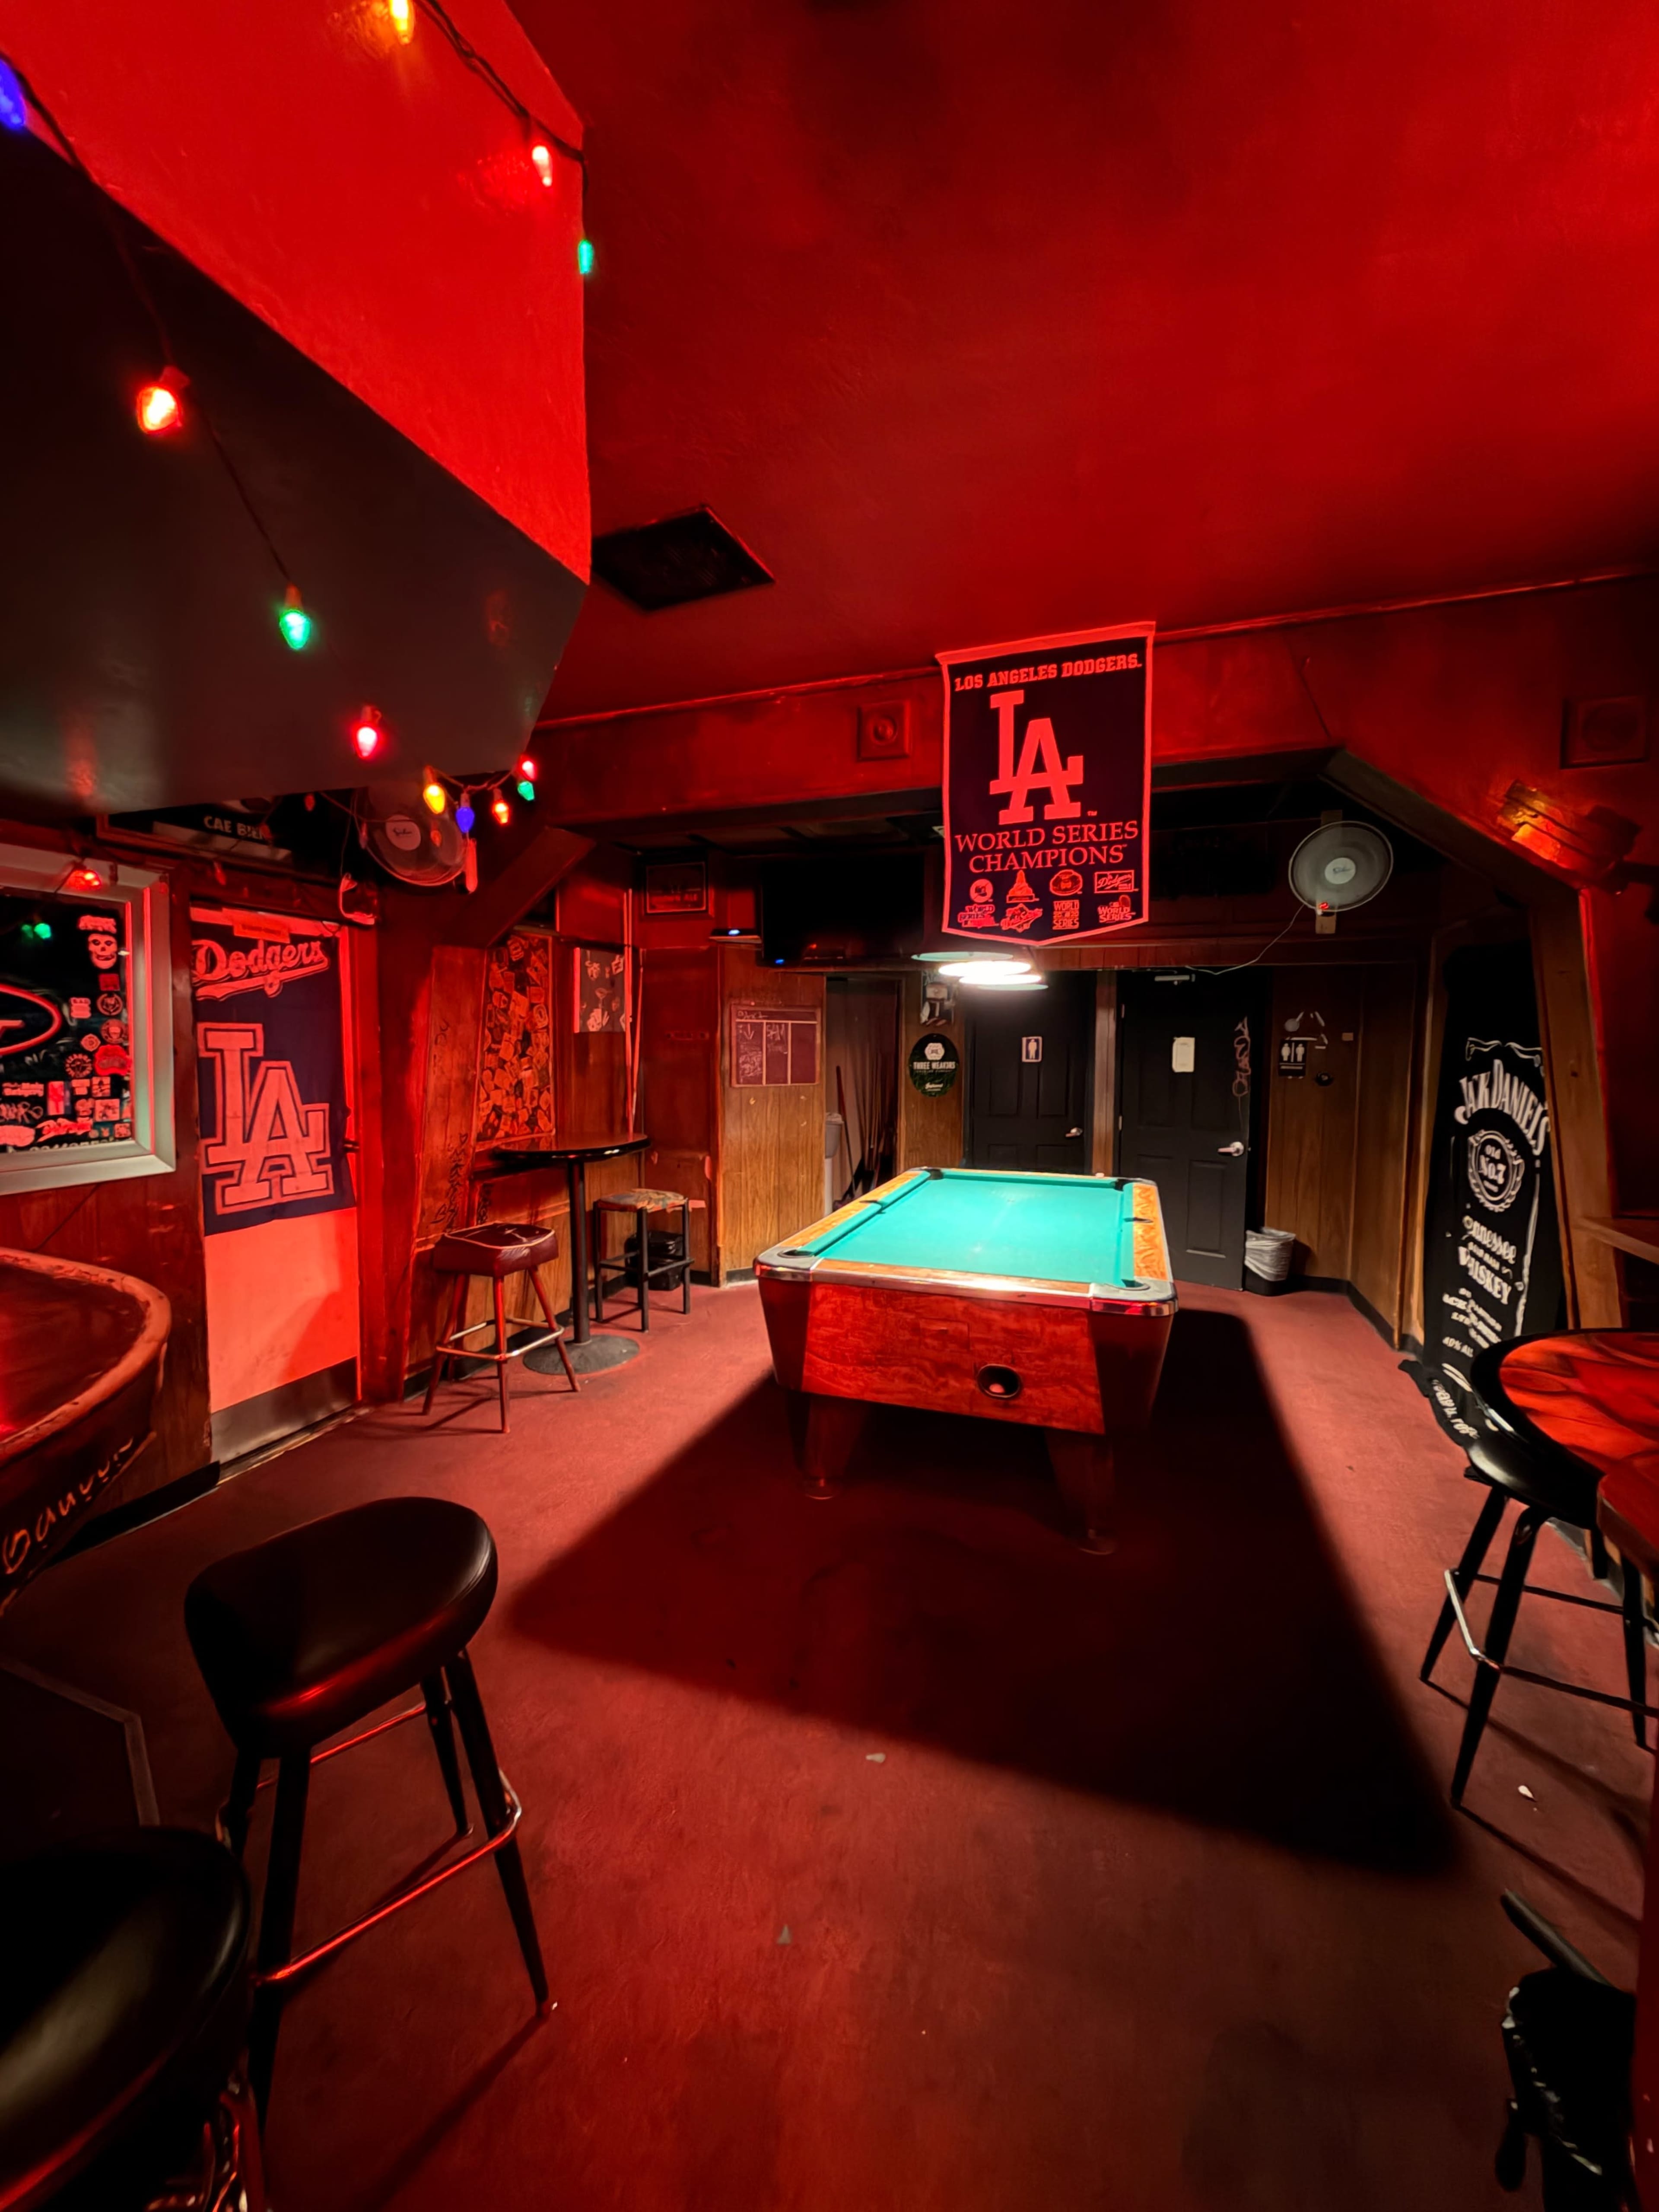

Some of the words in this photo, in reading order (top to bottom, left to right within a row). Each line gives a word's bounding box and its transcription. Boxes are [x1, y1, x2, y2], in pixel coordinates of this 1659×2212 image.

[954, 674, 983, 691] LOS
[987, 664, 1057, 687] ANGELES
[989, 690, 1084, 825] LA
[954, 828, 1045, 852] WORLD
[1052, 821, 1138, 844] SERIES
[969, 844, 1124, 873] CHAMPIONS
[191, 939, 329, 999] Dodgers
[197, 1022, 334, 1215] LA
